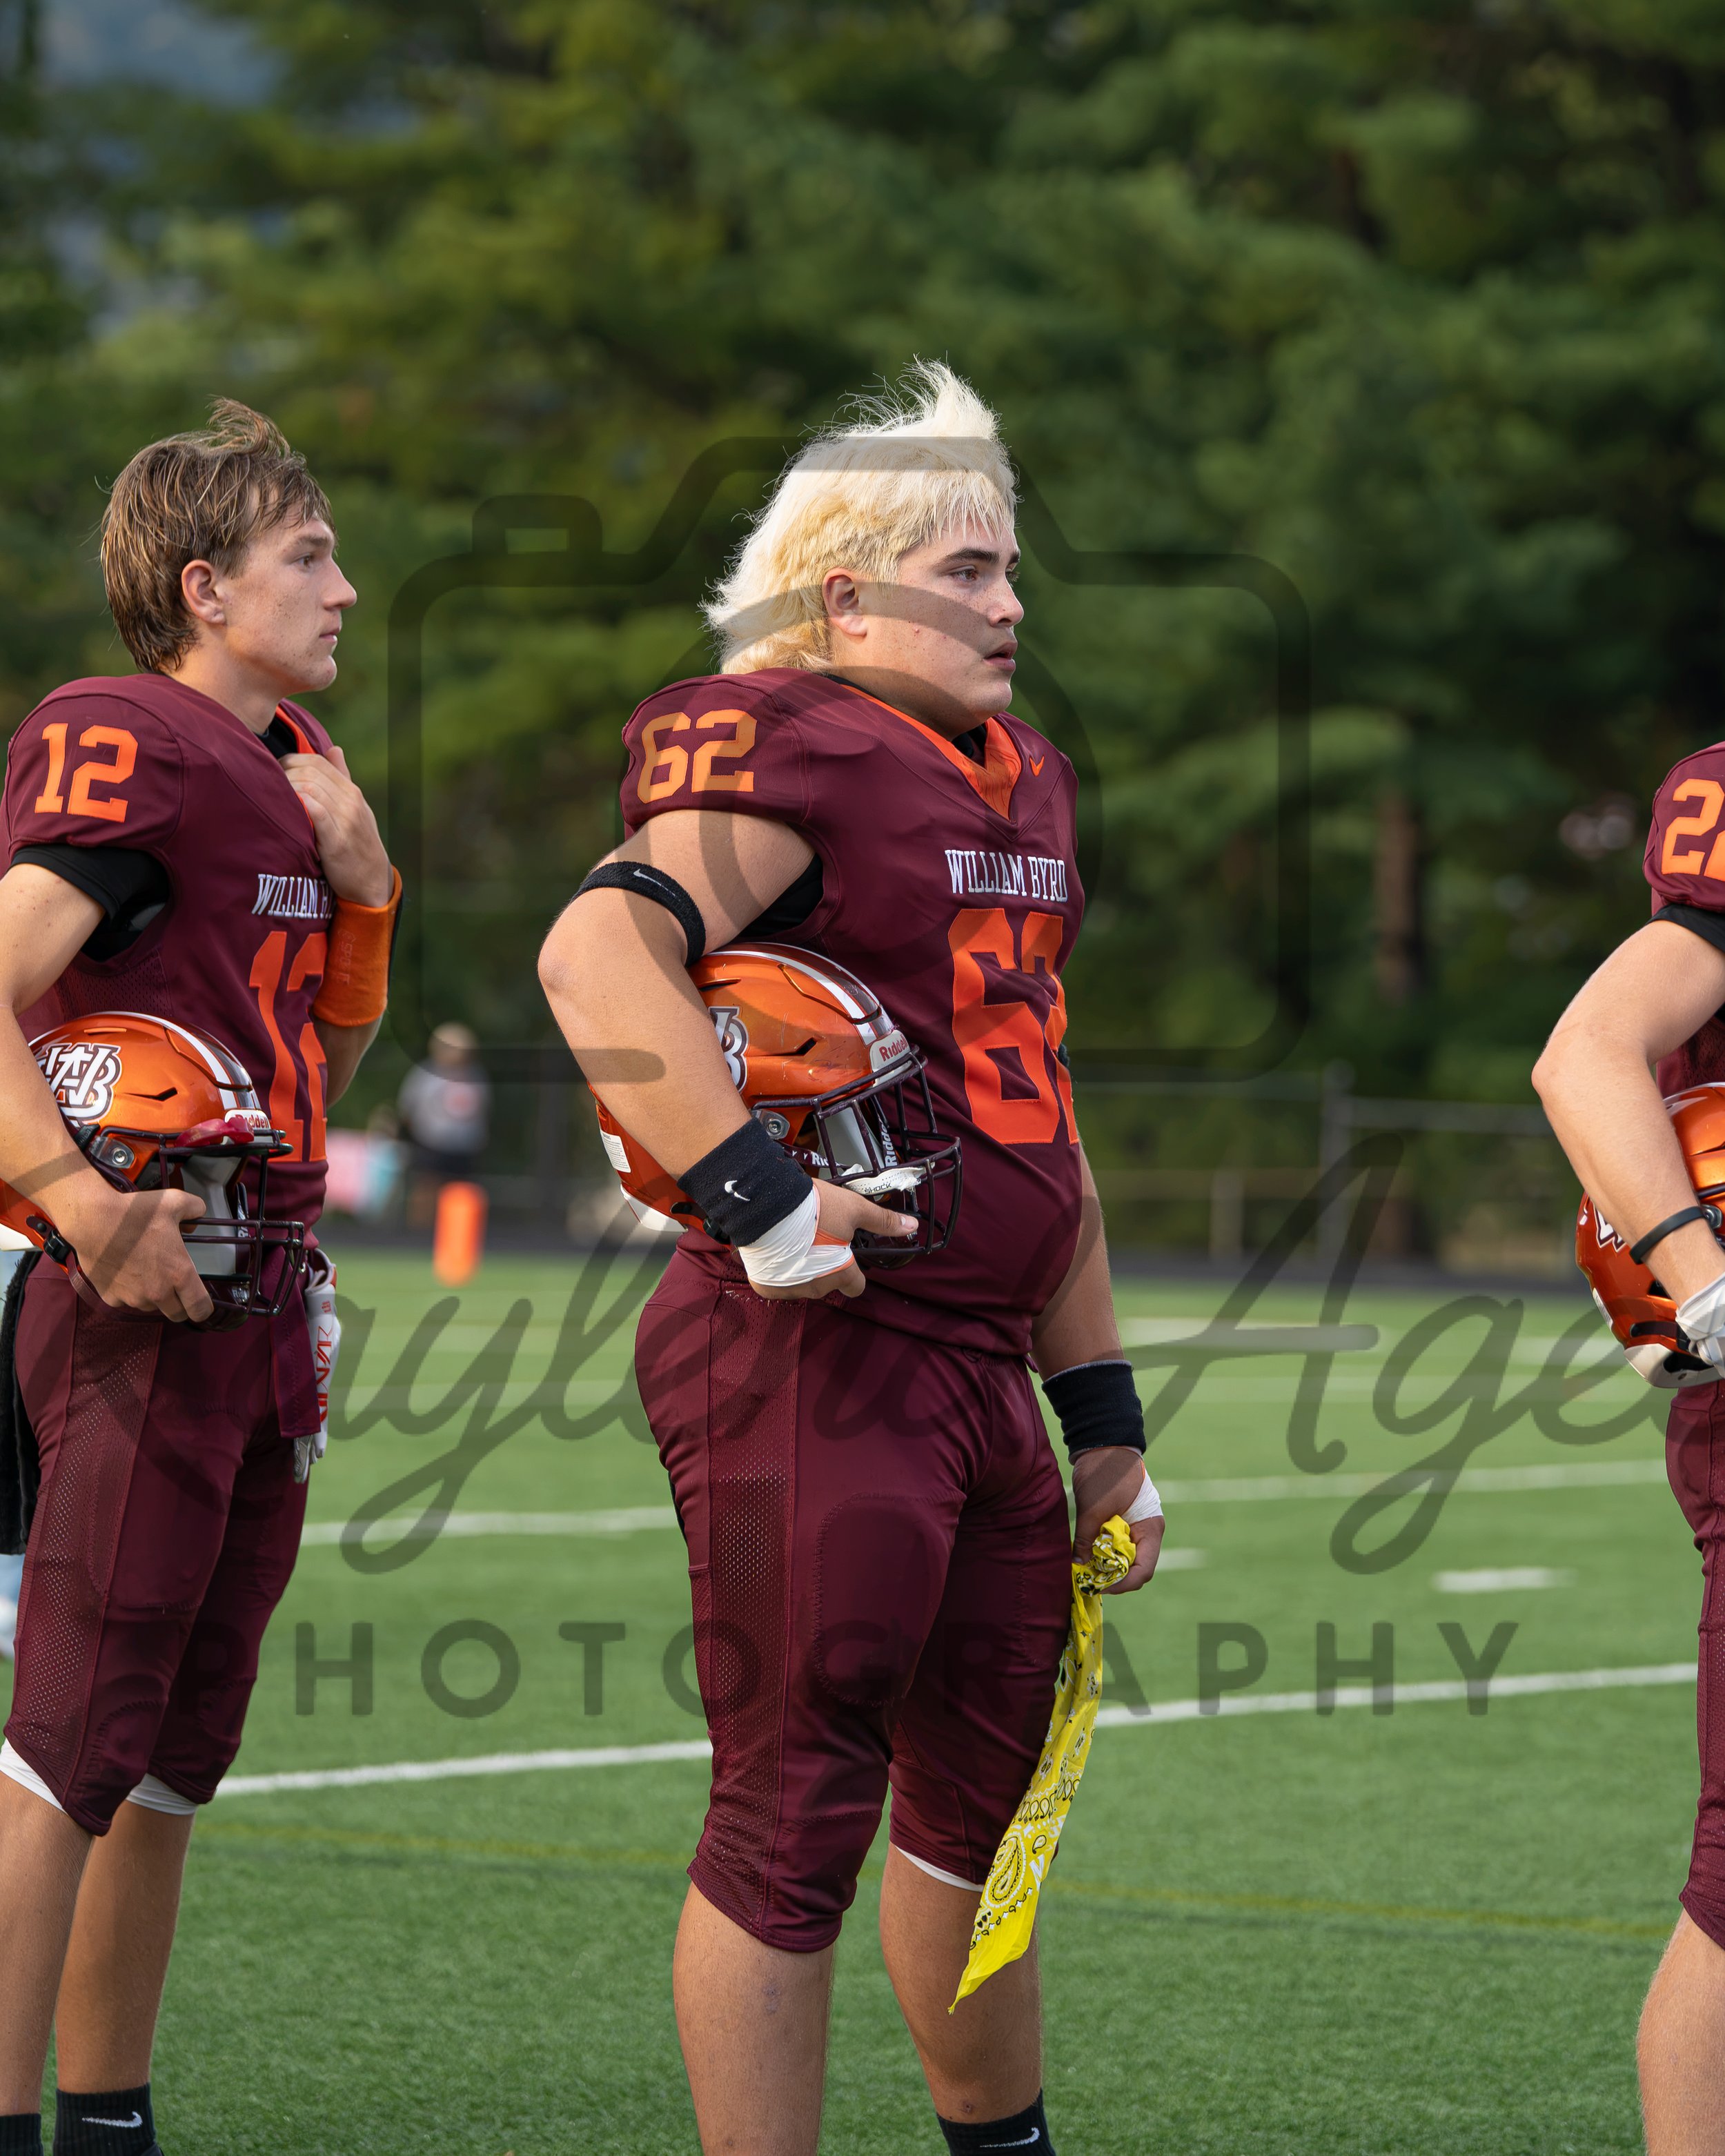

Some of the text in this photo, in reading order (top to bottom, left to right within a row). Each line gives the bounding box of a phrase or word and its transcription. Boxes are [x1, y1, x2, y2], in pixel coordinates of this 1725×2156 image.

[34, 722, 138, 823] 12
[636, 709, 757, 804] 62
[251, 873, 318, 918] WILLIAM
[945, 849, 1067, 902] WILLIAM BYRD
[878, 1034, 909, 1062] Riddell
